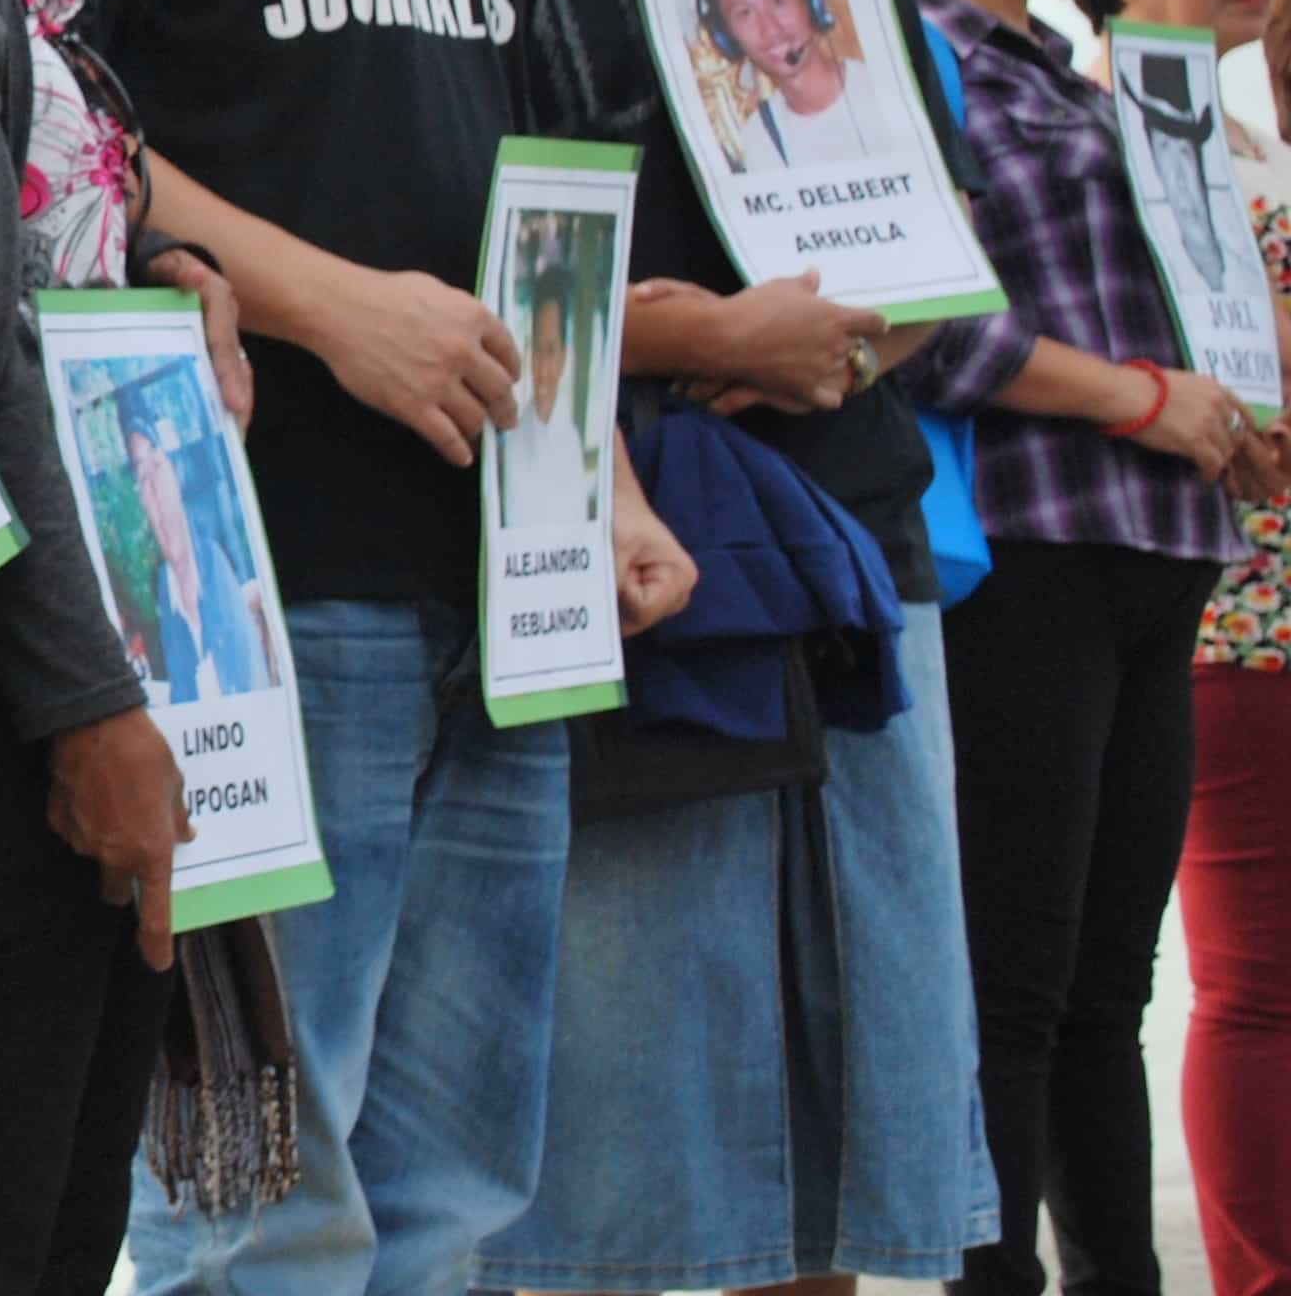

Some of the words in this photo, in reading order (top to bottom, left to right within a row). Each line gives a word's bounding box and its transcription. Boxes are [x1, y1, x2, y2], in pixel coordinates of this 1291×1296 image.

[743, 191, 793, 216] MC.
[798, 173, 912, 209] DELBERT
[795, 221, 907, 254] ARRIOLA
[504, 548, 590, 579] ALEJANDRO
[510, 605, 589, 639] REBLANDO
[182, 721, 245, 757] LINDO
